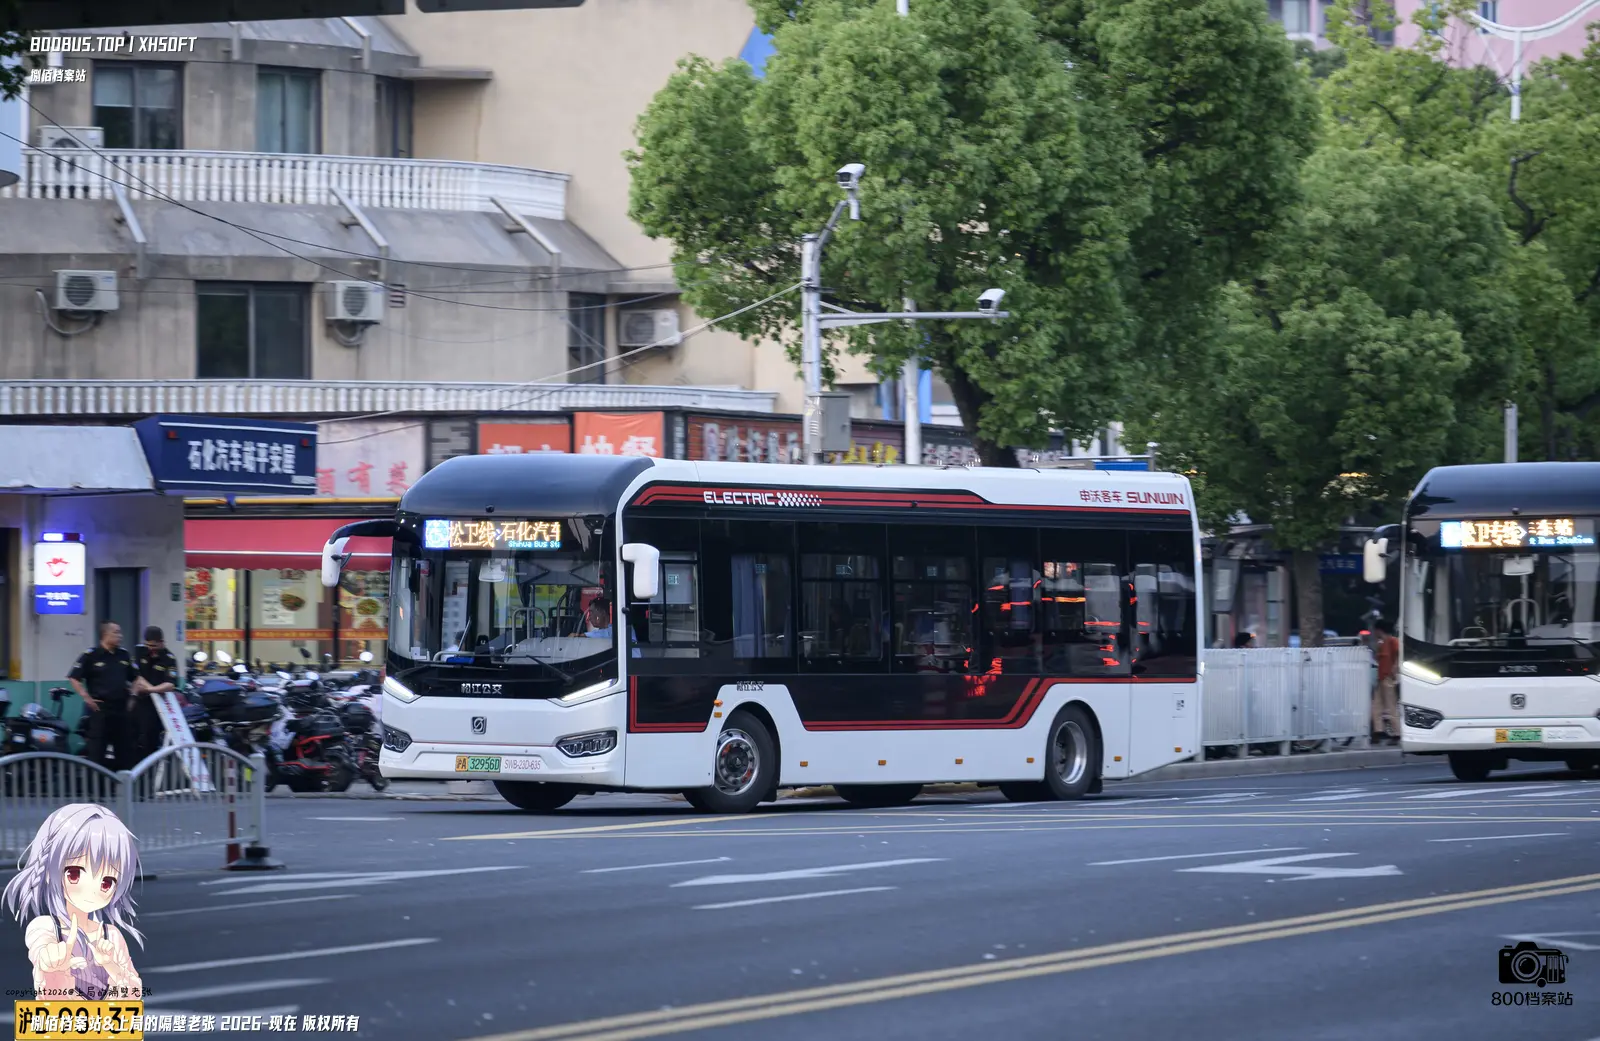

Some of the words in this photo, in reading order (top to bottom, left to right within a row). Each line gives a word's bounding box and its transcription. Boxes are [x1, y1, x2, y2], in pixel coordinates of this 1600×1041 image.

[188, 438, 296, 475] 石化汽车站平安屋
[703, 491, 776, 505] ELECTRIC
[1079, 489, 1123, 503] 申沃客车
[1126, 491, 1184, 505] SUNWIN
[449, 520, 496, 548] 松卫线
[534, 540, 548, 548] Bus
[461, 682, 502, 695] 松江公交
